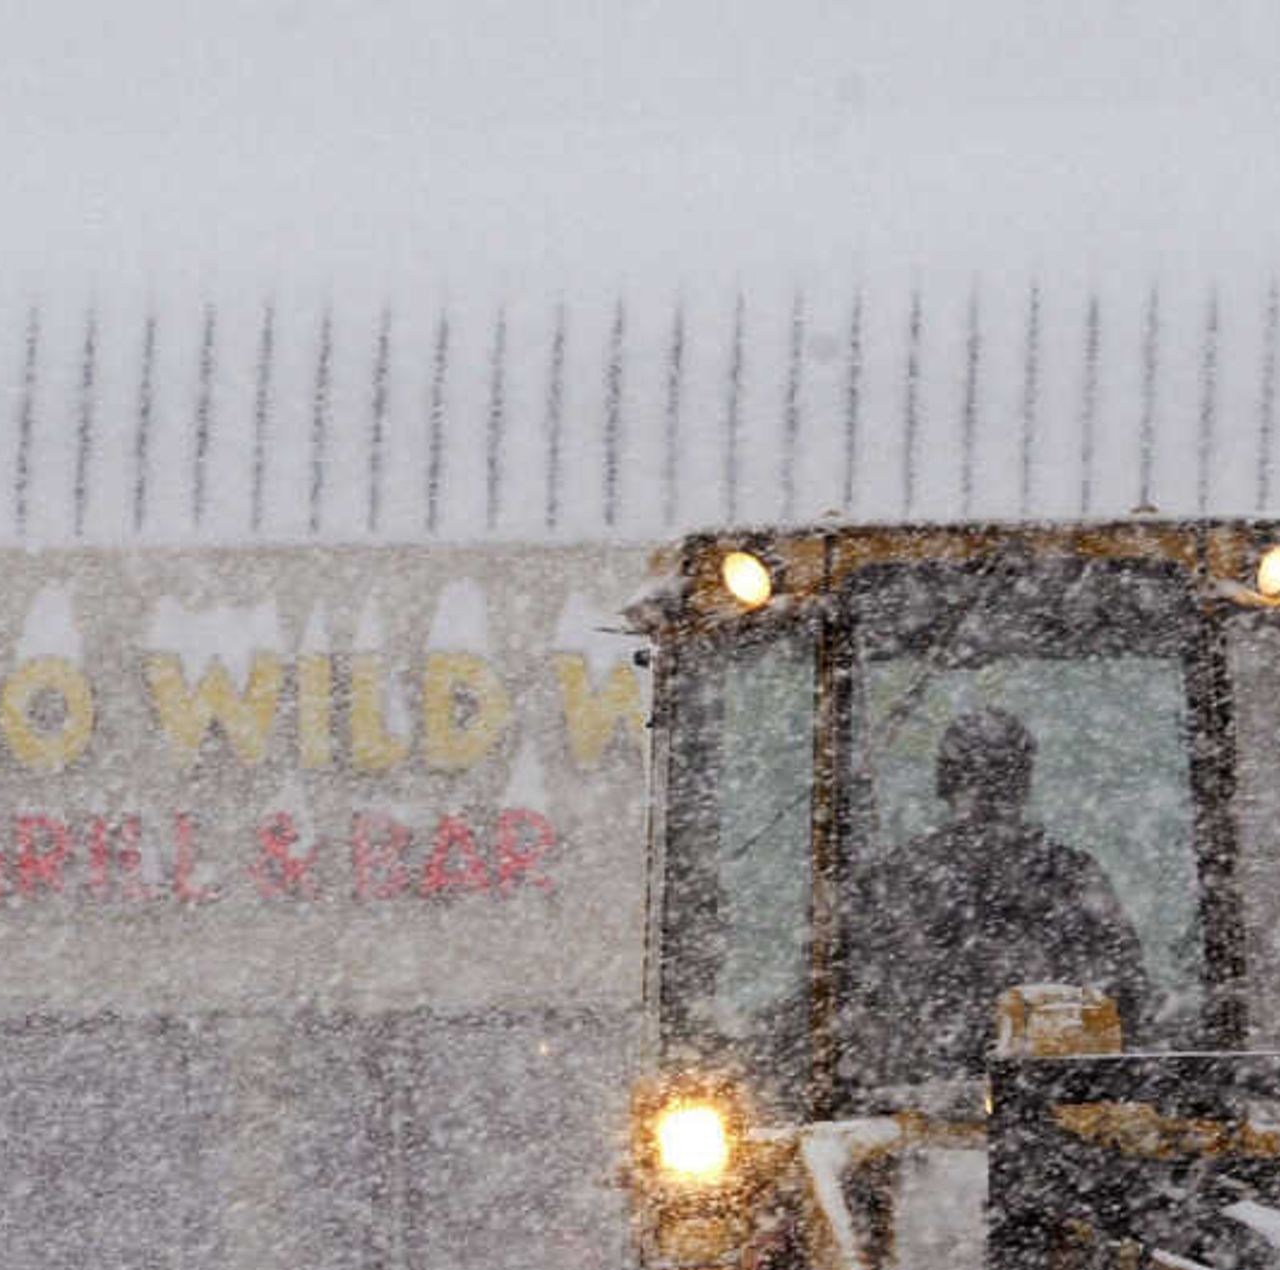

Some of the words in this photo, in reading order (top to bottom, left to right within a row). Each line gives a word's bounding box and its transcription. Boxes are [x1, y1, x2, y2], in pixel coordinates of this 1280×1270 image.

[140, 651, 516, 770] WILD
[250, 808, 322, 900] &
[350, 806, 556, 902] BAR
